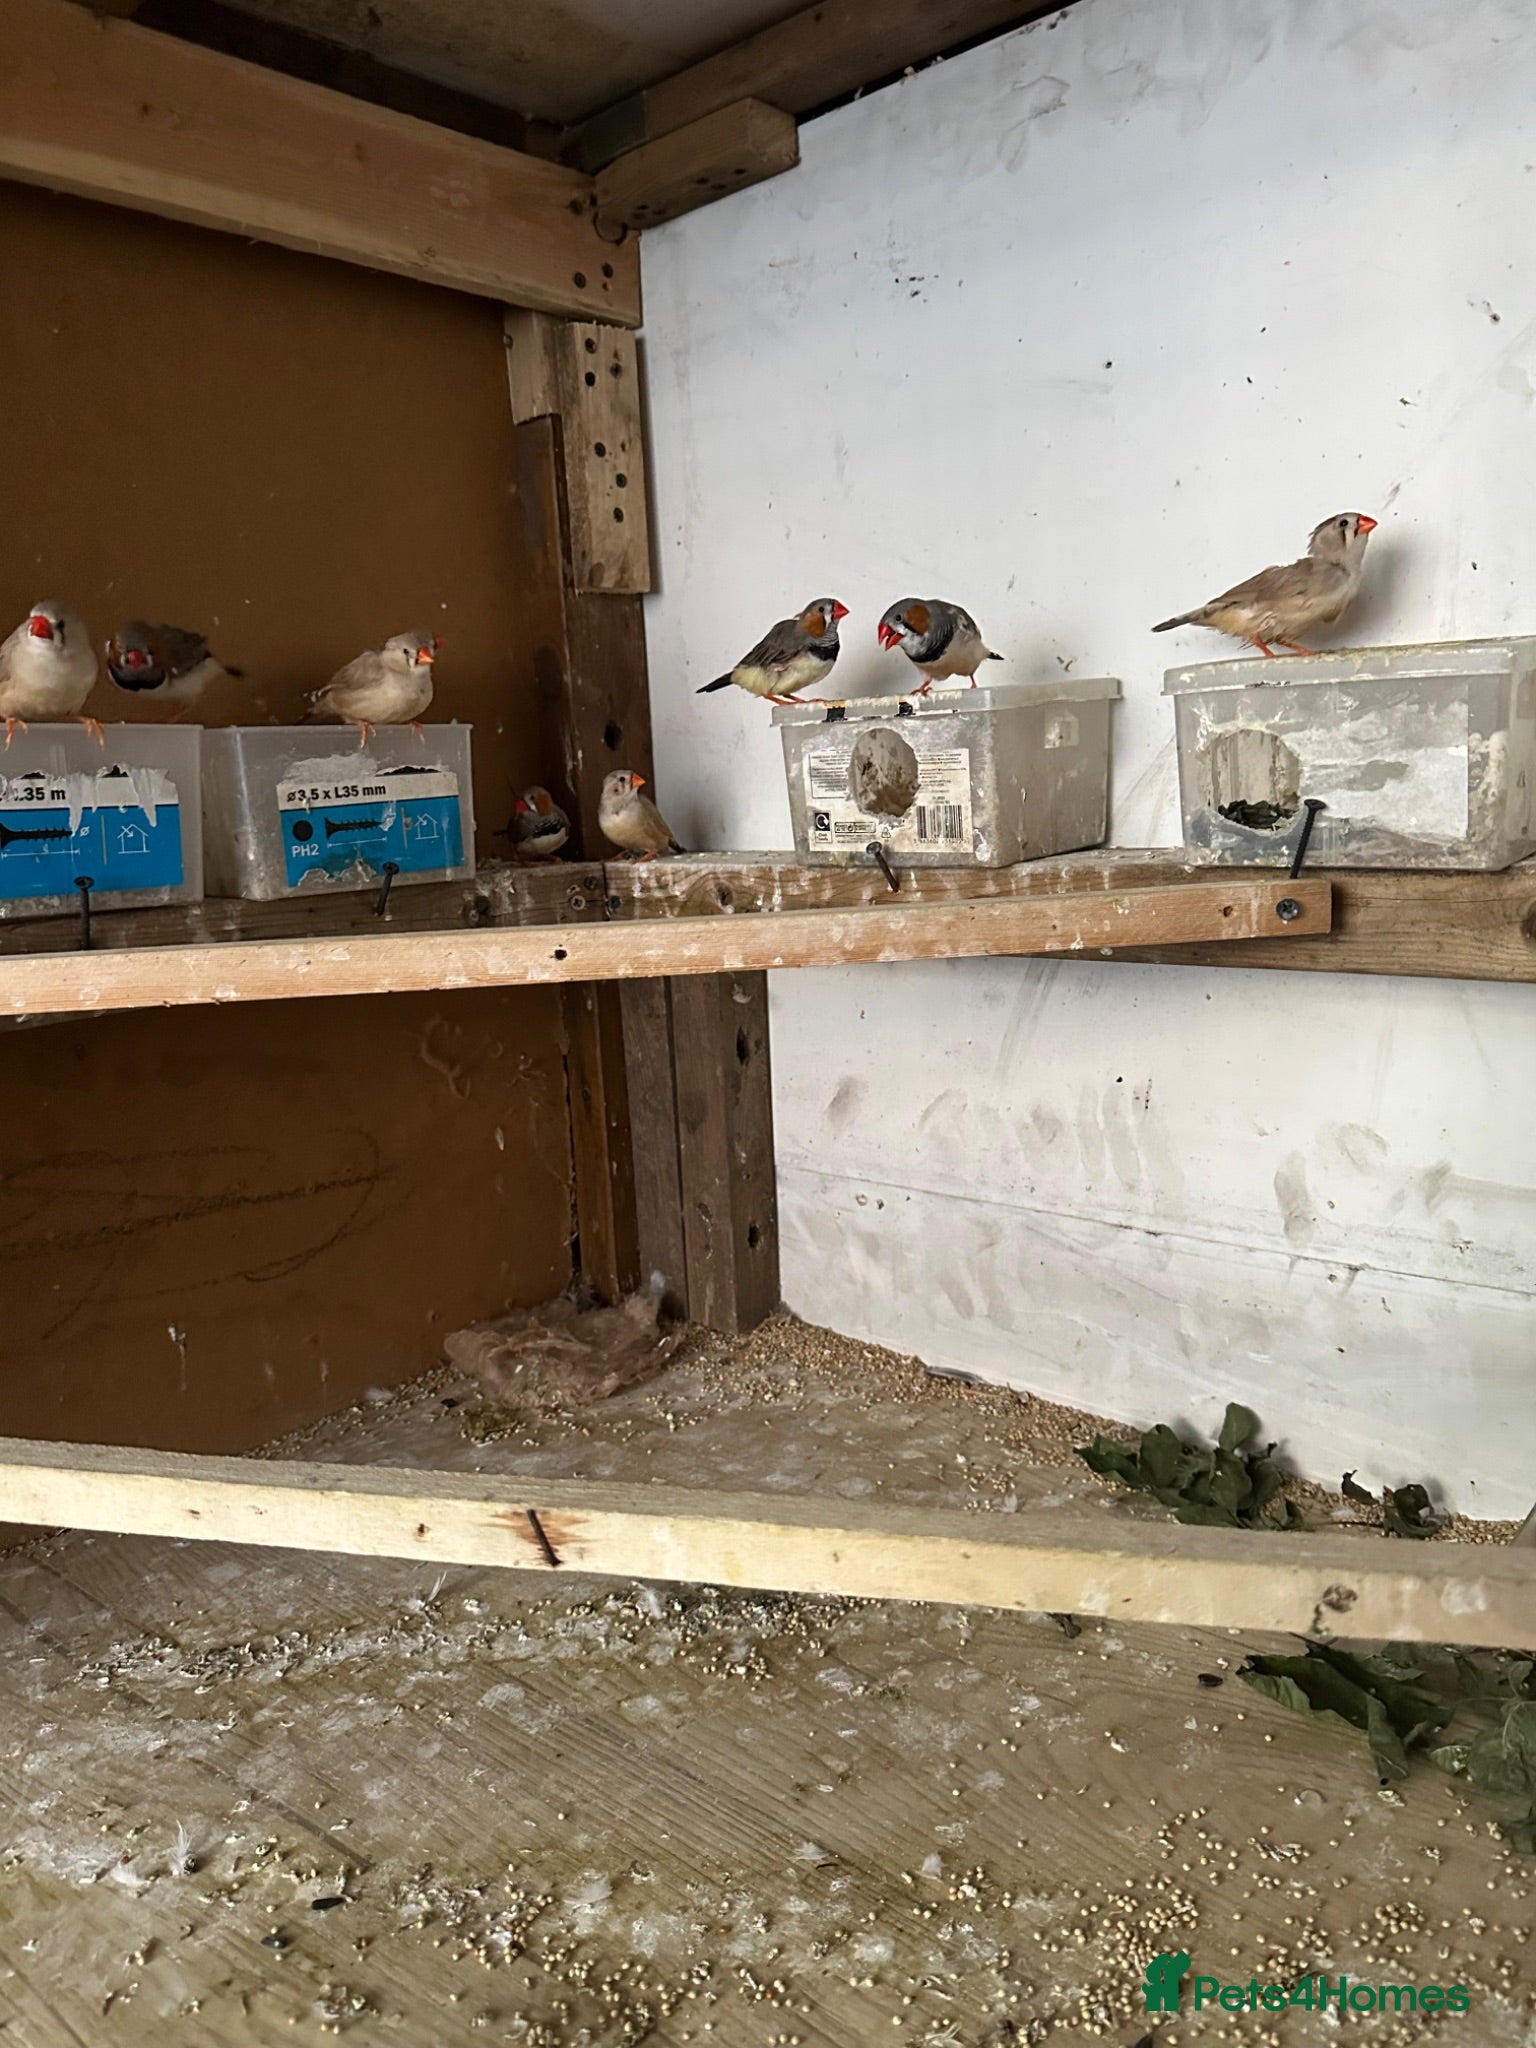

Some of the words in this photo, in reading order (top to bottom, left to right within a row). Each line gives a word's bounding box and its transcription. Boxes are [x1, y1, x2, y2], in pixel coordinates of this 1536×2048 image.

[322, 789, 332, 800] x
[335, 785, 359, 798] L35
[362, 785, 386, 796] mm
[291, 843, 319, 858] PH2
